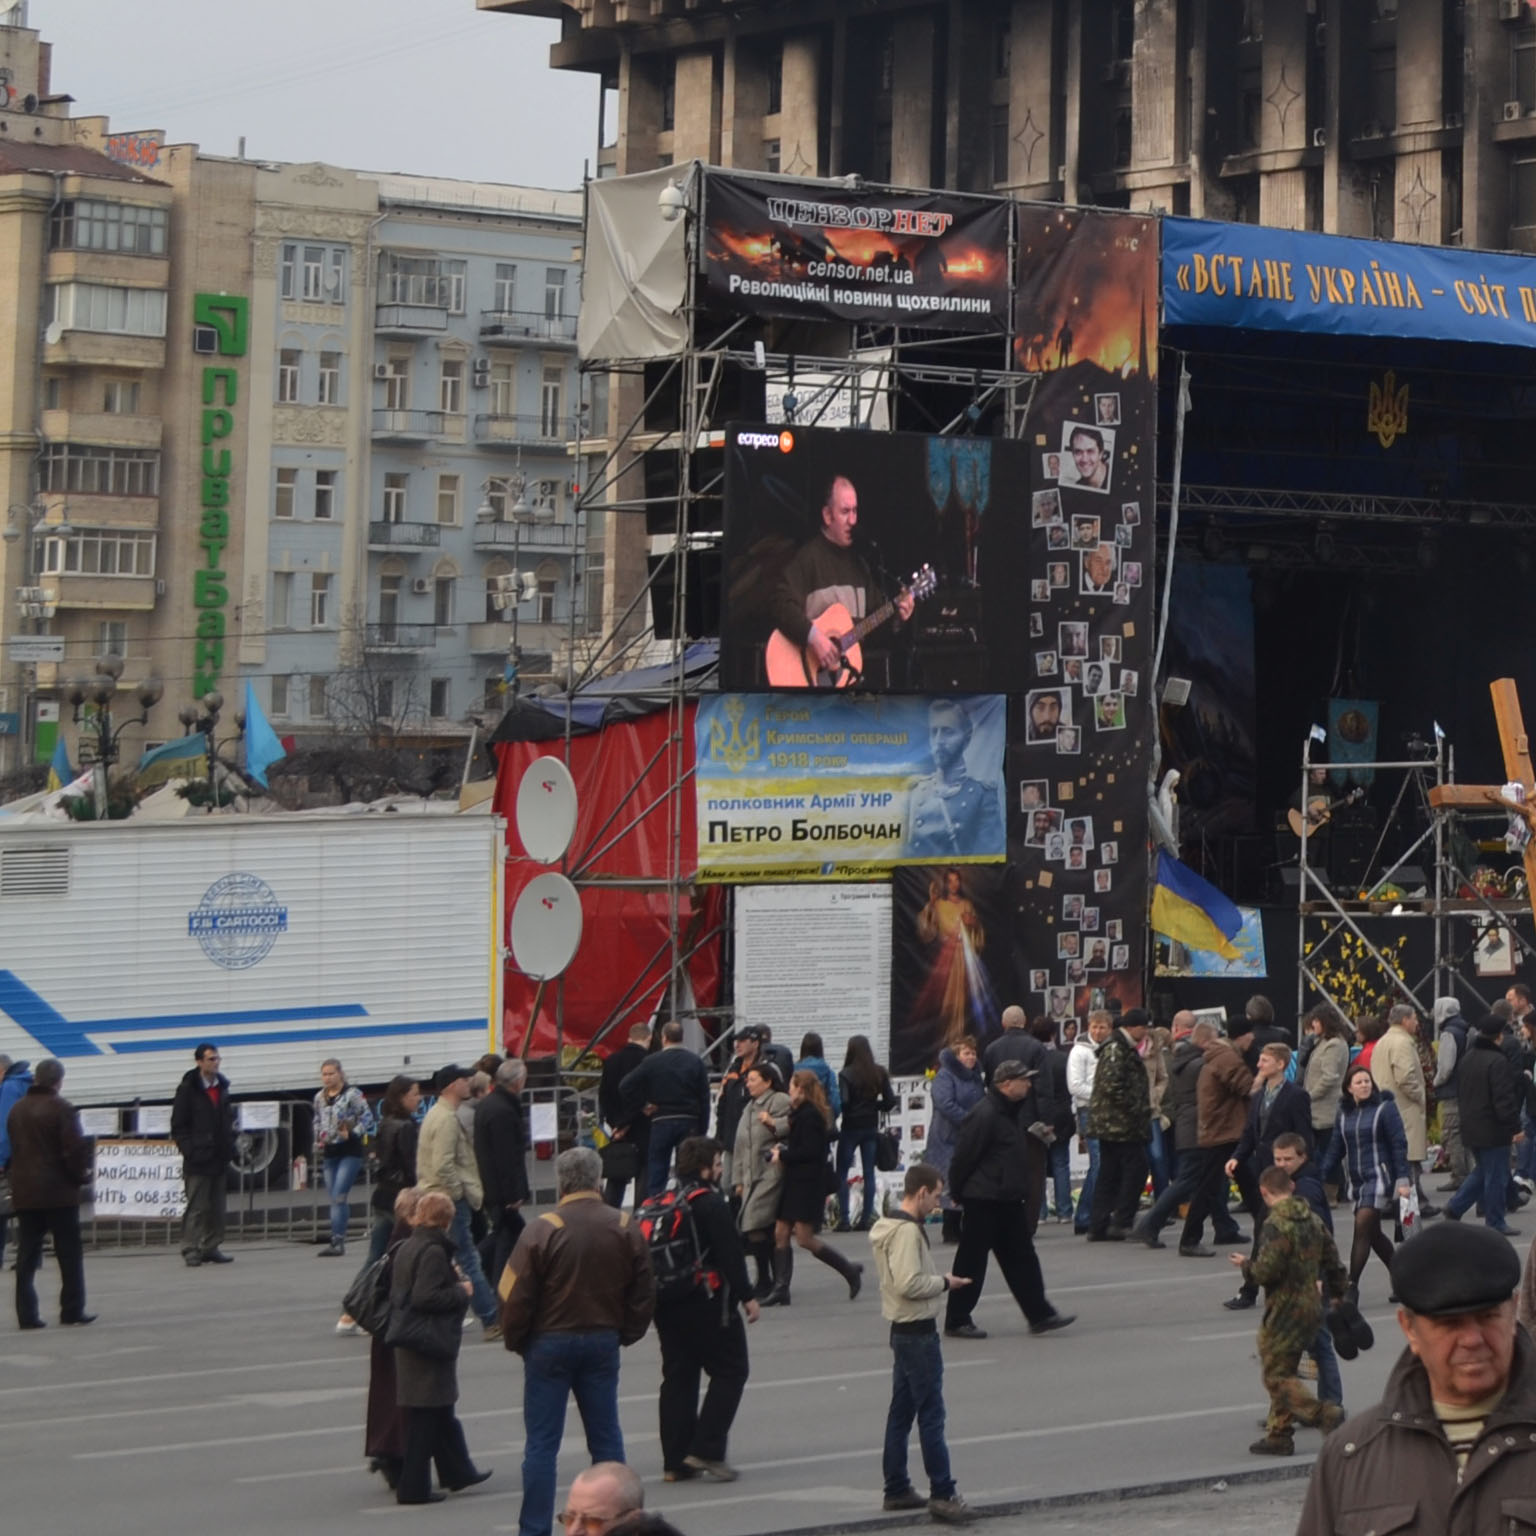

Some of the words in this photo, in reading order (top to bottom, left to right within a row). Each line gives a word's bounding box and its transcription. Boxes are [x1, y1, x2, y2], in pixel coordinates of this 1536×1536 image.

[766, 197, 953, 237] ЦЕНЗОР.НЕТ
[807, 260, 914, 285] censor.net.ua
[1309, 261, 1425, 311] УКРАЇНА
[729, 274, 830, 304] Революційні
[833, 290, 893, 308] новини
[896, 294, 991, 314] щохвилини
[708, 796, 805, 811] полковник
[810, 793, 856, 812] Армії
[860, 792, 893, 809] УНР
[217, 915, 279, 928] CARTOCCI
